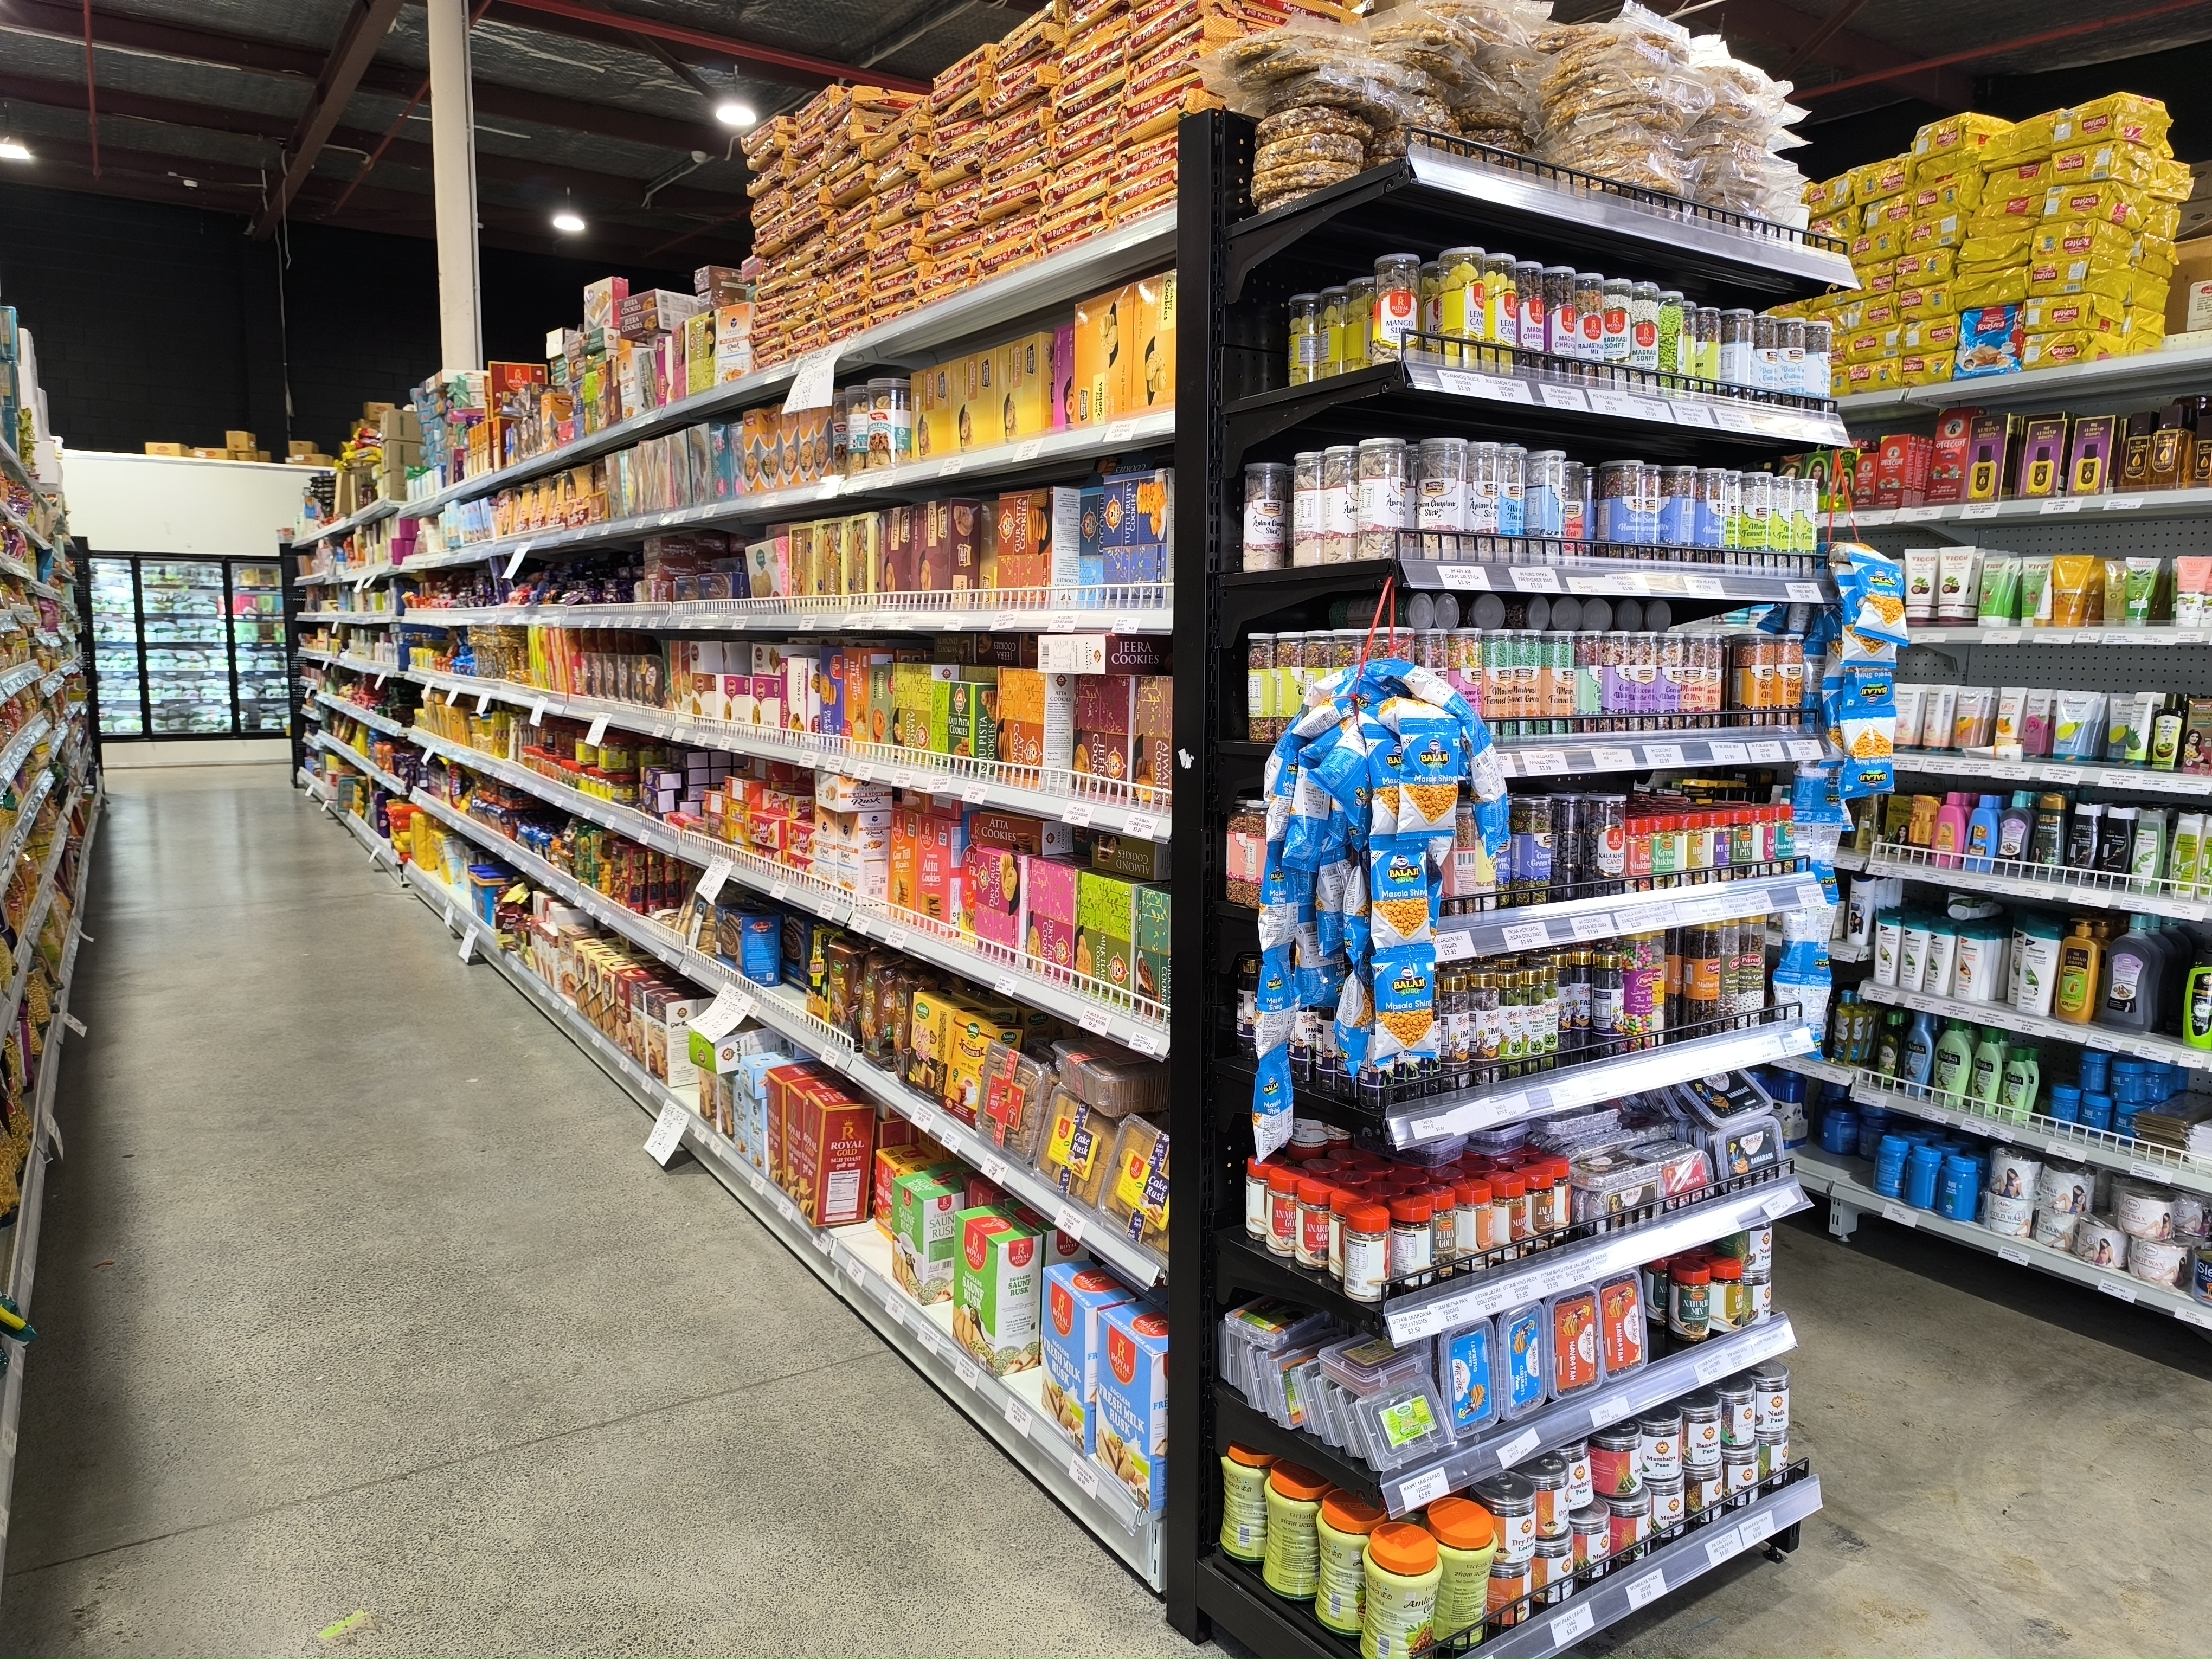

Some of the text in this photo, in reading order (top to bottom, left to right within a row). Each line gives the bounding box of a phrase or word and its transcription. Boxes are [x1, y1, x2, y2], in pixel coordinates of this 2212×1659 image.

[936, 637, 958, 646] ALMOND
[1119, 641, 1152, 653] JEERA
[996, 651, 1013, 660] JEERA
[1111, 653, 1159, 665] COOKIES
[948, 716, 970, 726] KAJU PISTA
[950, 725, 968, 736] COOKIES
[979, 716, 987, 745] PISTA
[851, 797, 882, 806] Rusk
[989, 818, 1009, 829] ATTA
[981, 828, 1017, 841] COOKIES
[923, 859, 938, 872] Atta
[1116, 861, 1150, 874] ALMOND
[922, 872, 941, 883] Cookies
[1388, 868, 1419, 877] BALAJI
[1381, 890, 1409, 898] Masala
[1741, 955, 1763, 965] Parag
[1393, 979, 1425, 989] BALAJI
[917, 1005, 928, 1014] Nanki
[1385, 1001, 1413, 1010] Masala
[1940, 1052, 1958, 1063] Vatika
[1074, 1133, 1090, 1145] Cake
[831, 1140, 864, 1150] ROYAL
[1072, 1144, 1088, 1155] Rusk
[1751, 1152, 1773, 1165] BANARASI
[1148, 1176, 1168, 1192] Cake
[1146, 1187, 1165, 1203] Rusk
[899, 1207, 915, 1222] SAUNF
[2131, 1214, 2146, 1222] WAX
[901, 1218, 914, 1236] RUSK
[966, 1247, 983, 1262] ROYAL
[969, 1255, 980, 1266] GOLD
[2146, 1259, 2164, 1268] WAX
[964, 1271, 982, 1288] EGGLESS
[1573, 1273, 1585, 1282] $3.50
[962, 1276, 984, 1298] SAUNF
[1008, 1278, 1032, 1289] SAUNF
[1514, 1284, 1529, 1294] 200GMS
[1010, 1287, 1029, 1296] RUSK
[1474, 1291, 1488, 1300] UTTAM
[964, 1291, 982, 1311] RUSK
[1487, 1294, 1502, 1302] 200GMS
[1446, 1300, 1458, 1308] MITHA
[1484, 1302, 1497, 1310] $3.50
[1443, 1307, 1459, 1315] 150GMS
[1053, 1309, 1069, 1327] ROYAL
[1392, 1310, 1432, 1324] UTTAM ANARDANA
[1410, 1318, 1427, 1327] 175GMS
[1445, 1314, 1458, 1322] $3.50
[1055, 1317, 1067, 1331] GOLD
[1407, 1327, 1421, 1335] $3.50
[1616, 1323, 1624, 1362] NAVRATAN
[1052, 1339, 1069, 1358] EGGLESS
[1043, 1336, 1081, 1382] FRESH MILK
[1111, 1353, 1131, 1375] ROYAL
[1052, 1360, 1069, 1386] RUSK
[1114, 1364, 1127, 1378] GOLD
[1110, 1385, 1131, 1408] EGGLESS
[1099, 1382, 1145, 1435] FRESH MILK
[1109, 1406, 1130, 1437] RUSK
[1404, 1472, 1441, 1491] NANKI AAM PAPAD
[1416, 1483, 1432, 1493] 150GMS
[1418, 1490, 1431, 1500] $2.99
[1743, 1516, 1768, 1532] BANARASI PAAN
[1716, 1534, 1733, 1546] CALCUTTA
[1713, 1540, 1733, 1554] METHA PAAN
[1719, 1547, 1729, 1558] $5.99
[1630, 1574, 1658, 1591] MUMBAIYA PAAN
[1639, 1584, 1651, 1593] 250GM
[1641, 1590, 1651, 1599] $5.99
[1403, 1597, 1430, 1609] Amla
[1561, 1616, 1572, 1625] PAAN
[1572, 1607, 1586, 1618] LEAVES
[1566, 1625, 1578, 1636] $5.99
